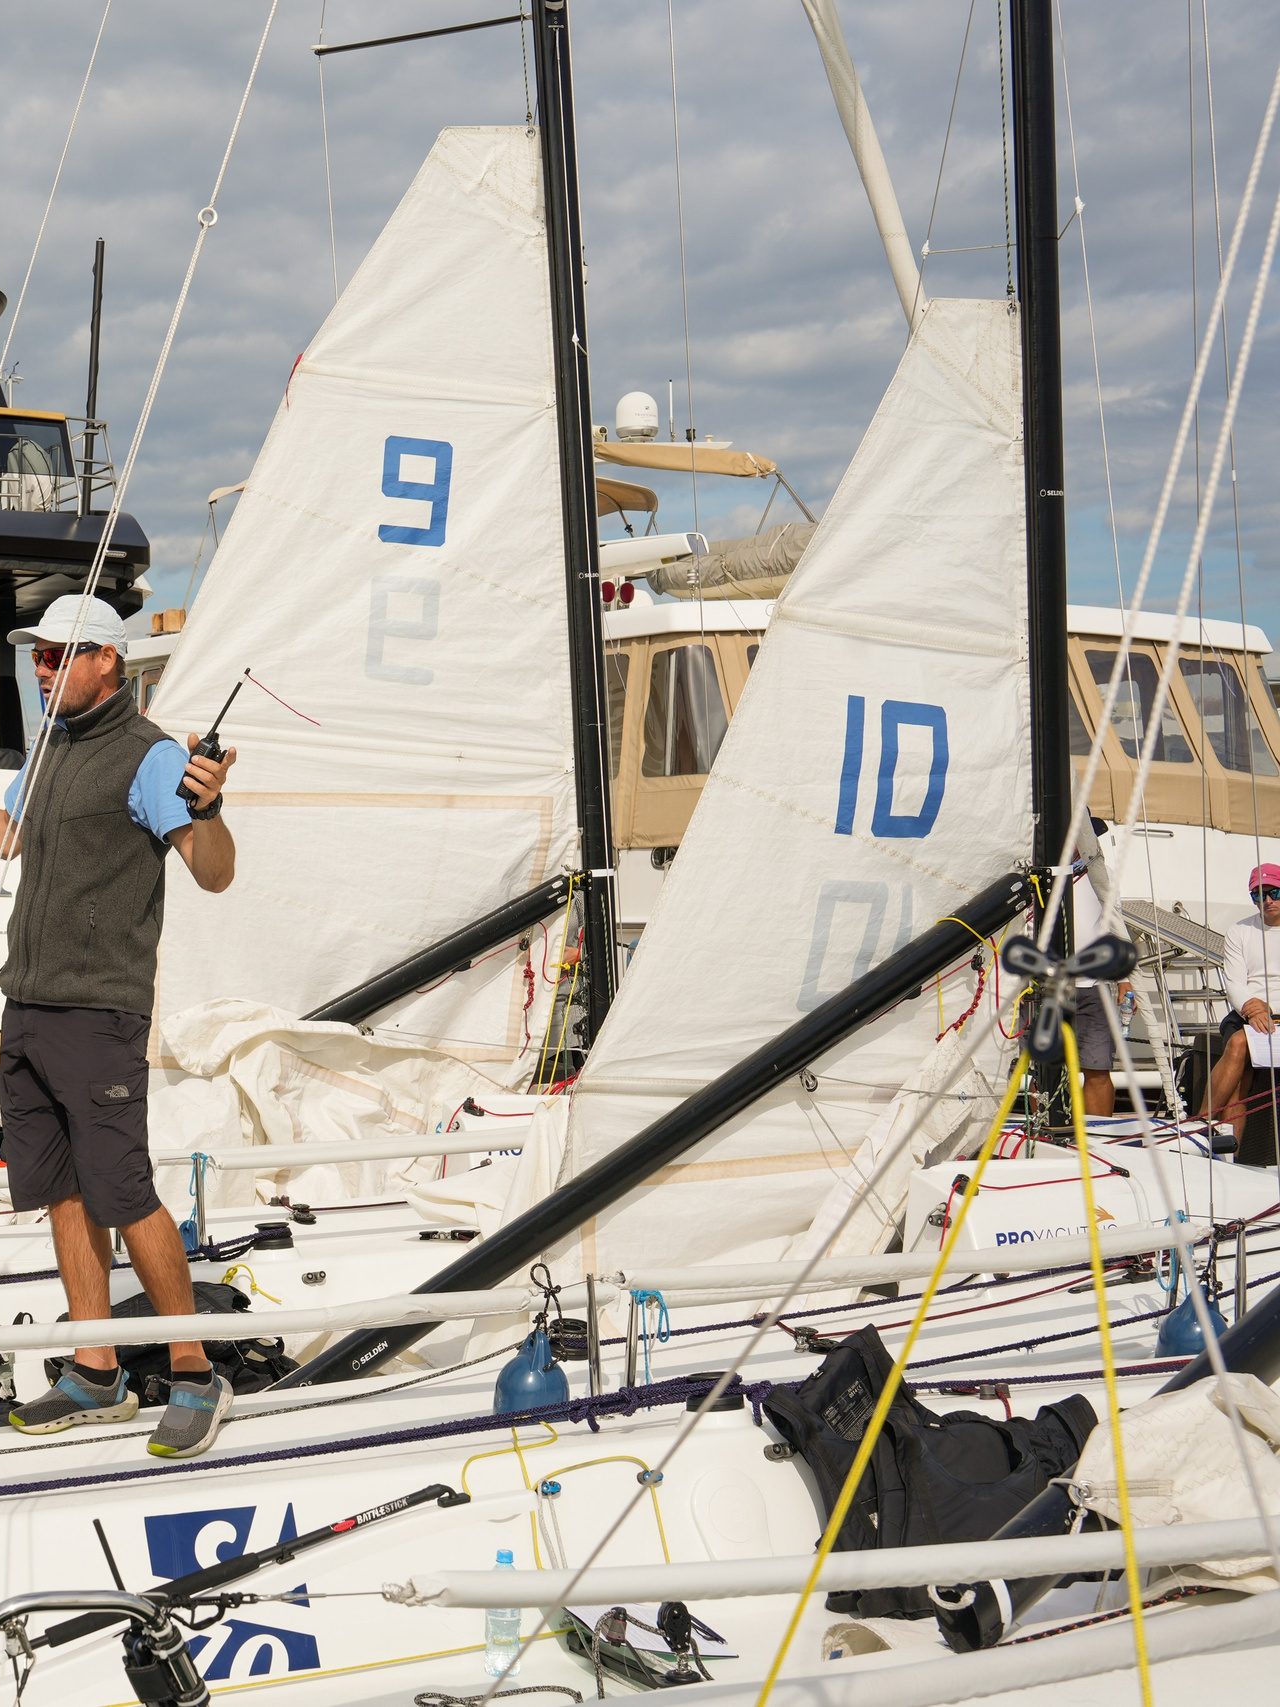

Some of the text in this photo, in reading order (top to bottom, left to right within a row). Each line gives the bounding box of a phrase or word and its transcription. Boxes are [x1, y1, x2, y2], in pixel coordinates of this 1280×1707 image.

[378, 435, 453, 547] 9
[834, 695, 949, 838] 10
[356, 1498, 408, 1524] BATTLESTICK
